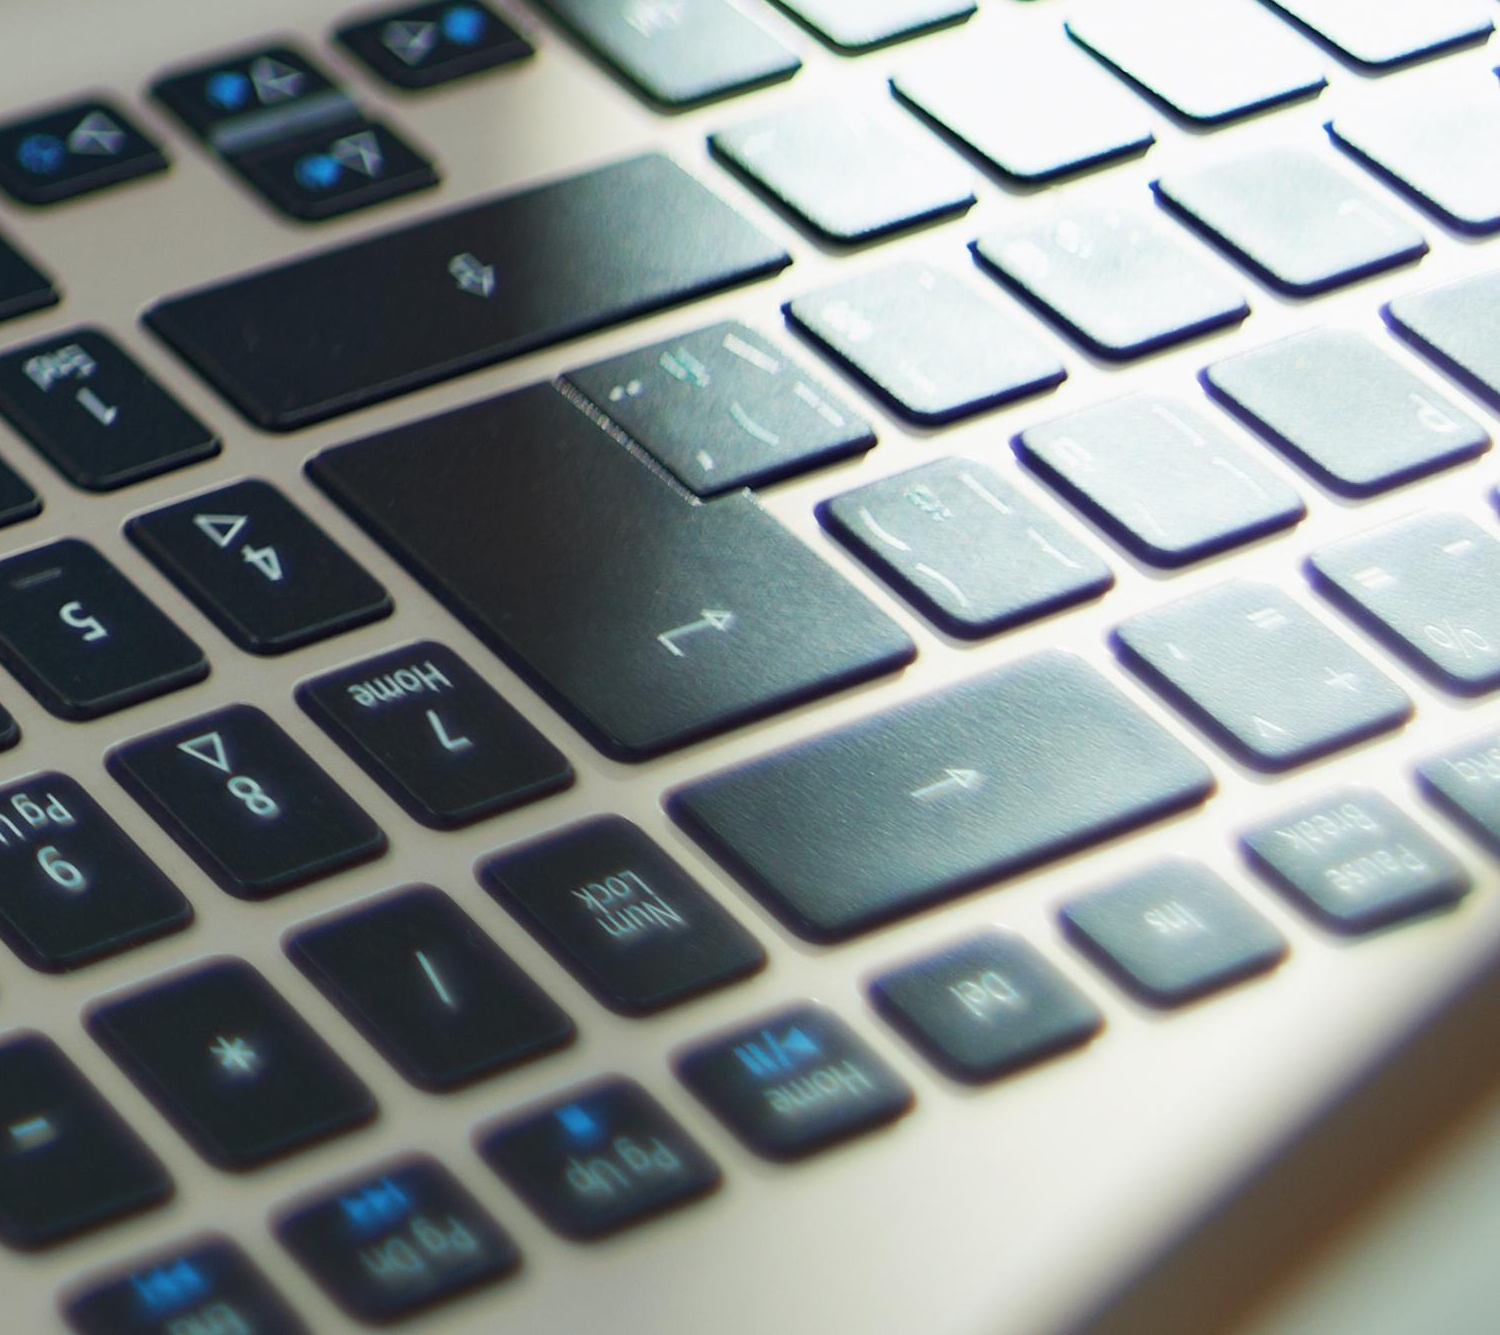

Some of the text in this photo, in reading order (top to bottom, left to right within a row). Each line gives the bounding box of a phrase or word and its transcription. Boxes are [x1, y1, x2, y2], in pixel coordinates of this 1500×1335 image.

[75, 388, 117, 424] 1
[242, 544, 283, 581] 4
[59, 602, 107, 640] 5
[1423, 617, 1489, 658] %
[348, 662, 454, 708] Home
[426, 708, 472, 753] 7
[11, 792, 76, 827] Pg
[227, 776, 279, 816] 8
[1275, 802, 1380, 853] Break
[36, 846, 86, 891] 9
[571, 868, 655, 911] Lock
[1326, 844, 1428, 892] Pause
[596, 892, 684, 940] Num
[948, 970, 1015, 1019] Del
[766, 1060, 873, 1115] Home
